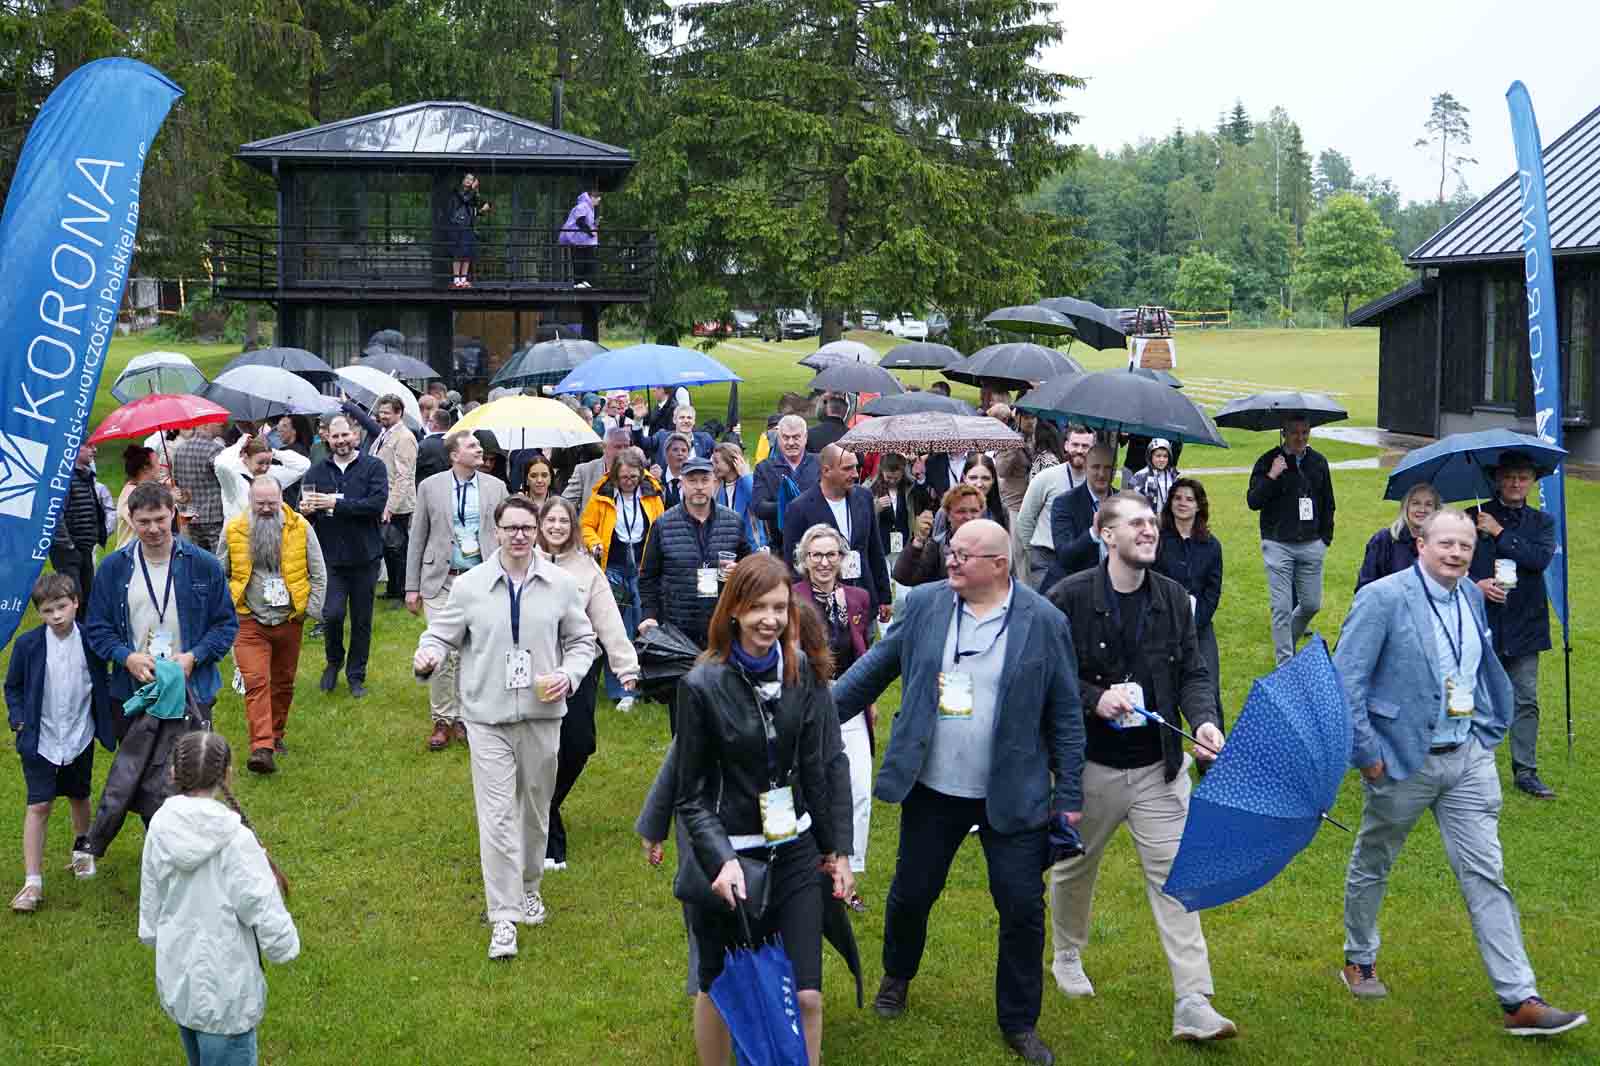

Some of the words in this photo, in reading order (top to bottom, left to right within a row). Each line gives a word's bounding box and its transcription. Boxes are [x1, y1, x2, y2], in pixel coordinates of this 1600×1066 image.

[14, 157, 125, 424] KORONA
[32, 496, 63, 560] Forum
[126, 200, 140, 226] na
